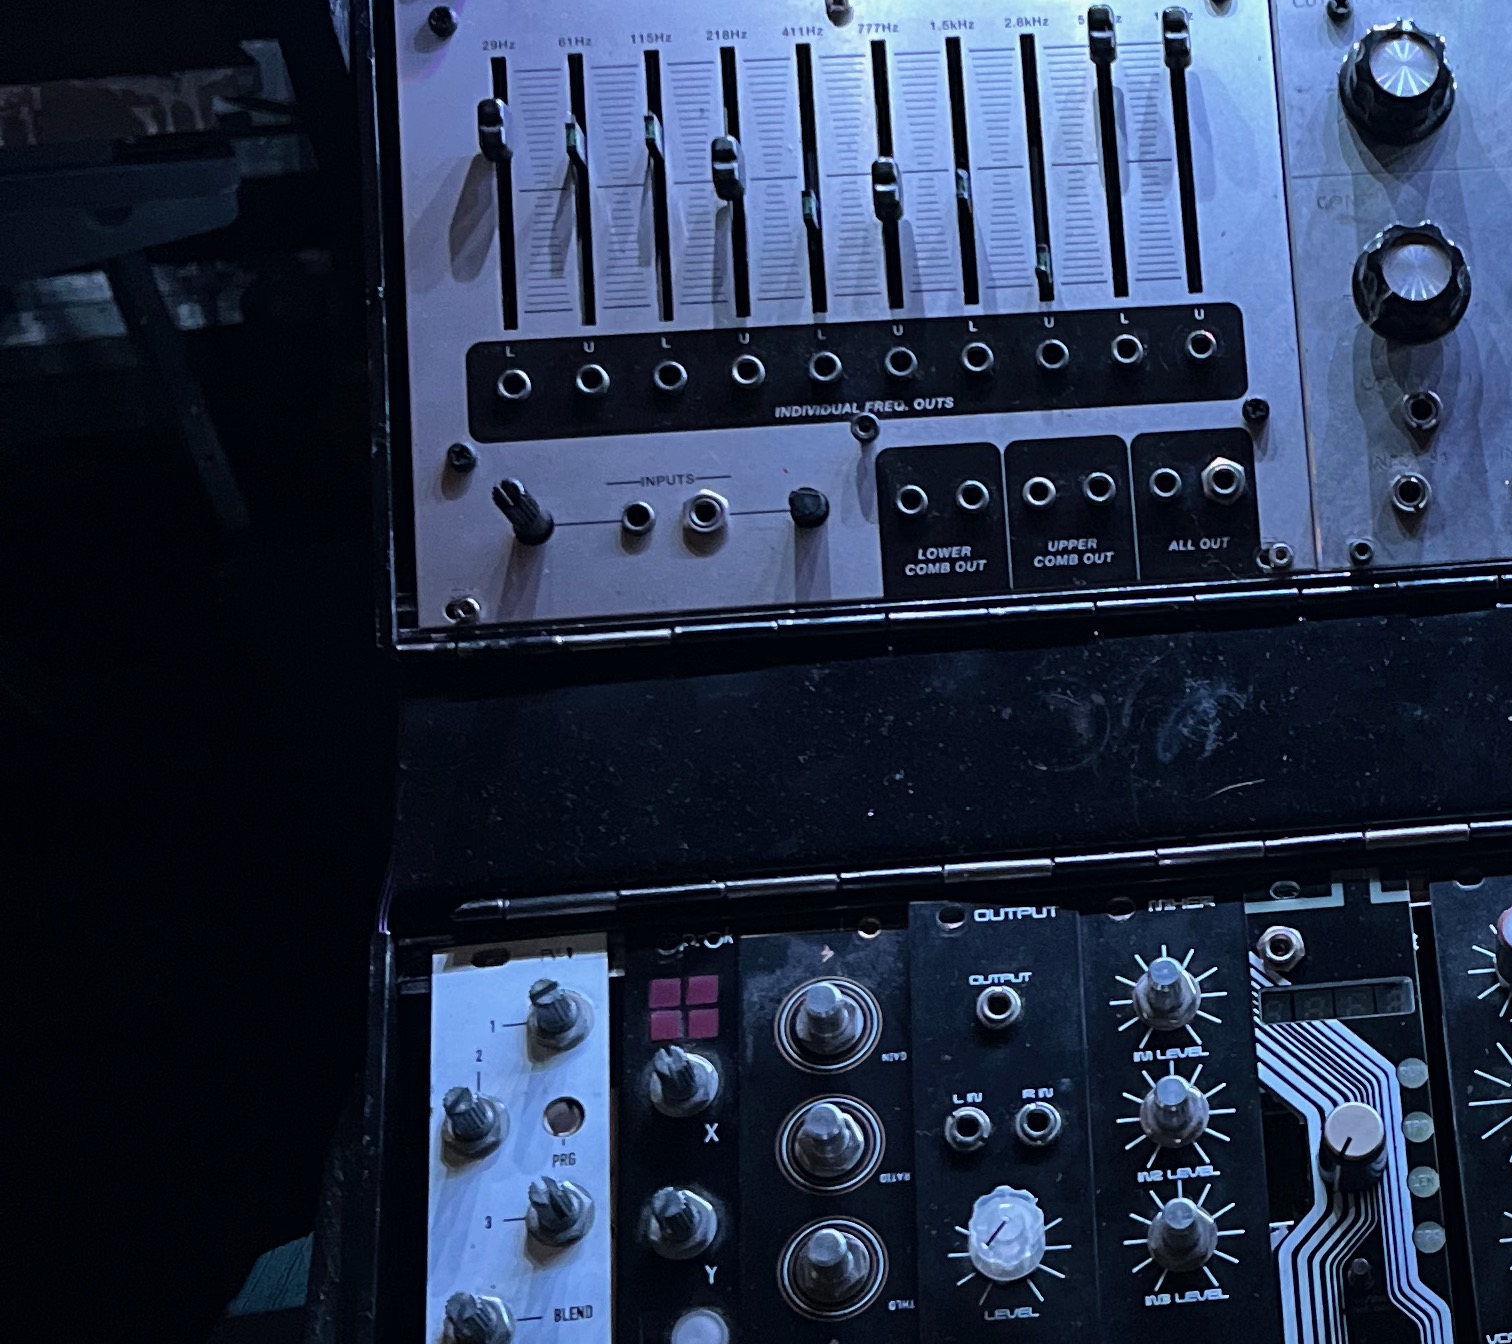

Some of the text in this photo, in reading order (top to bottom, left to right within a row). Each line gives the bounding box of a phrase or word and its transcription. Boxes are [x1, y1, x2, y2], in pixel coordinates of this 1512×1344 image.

[858, 23, 899, 35] 777Hz
[930, 19, 975, 32] 1.5kHz
[1004, 17, 1049, 29] 2.8kHz
[706, 29, 747, 42] 218Hz
[782, 26, 823, 38] 411Hz
[558, 36, 592, 48] 61Hz
[631, 33, 672, 45] 115Hz
[482, 41, 515, 51] 29Hz
[775, 403, 861, 418] INDIVIDUAL
[914, 397, 954, 411] OUTS
[640, 474, 695, 487] INPUTS
[1048, 538, 1098, 552] UPPER
[1168, 536, 1230, 551] ALL OUT
[918, 546, 971, 560] LOWER
[1034, 551, 1114, 568] COMB OUT
[905, 560, 986, 576] COMB OUT
[974, 905, 1057, 922] OUTPUT
[969, 972, 1031, 985] OUTPUT
[554, 1305, 593, 1322] BLEND
[984, 1308, 1040, 1320] LEVEL
